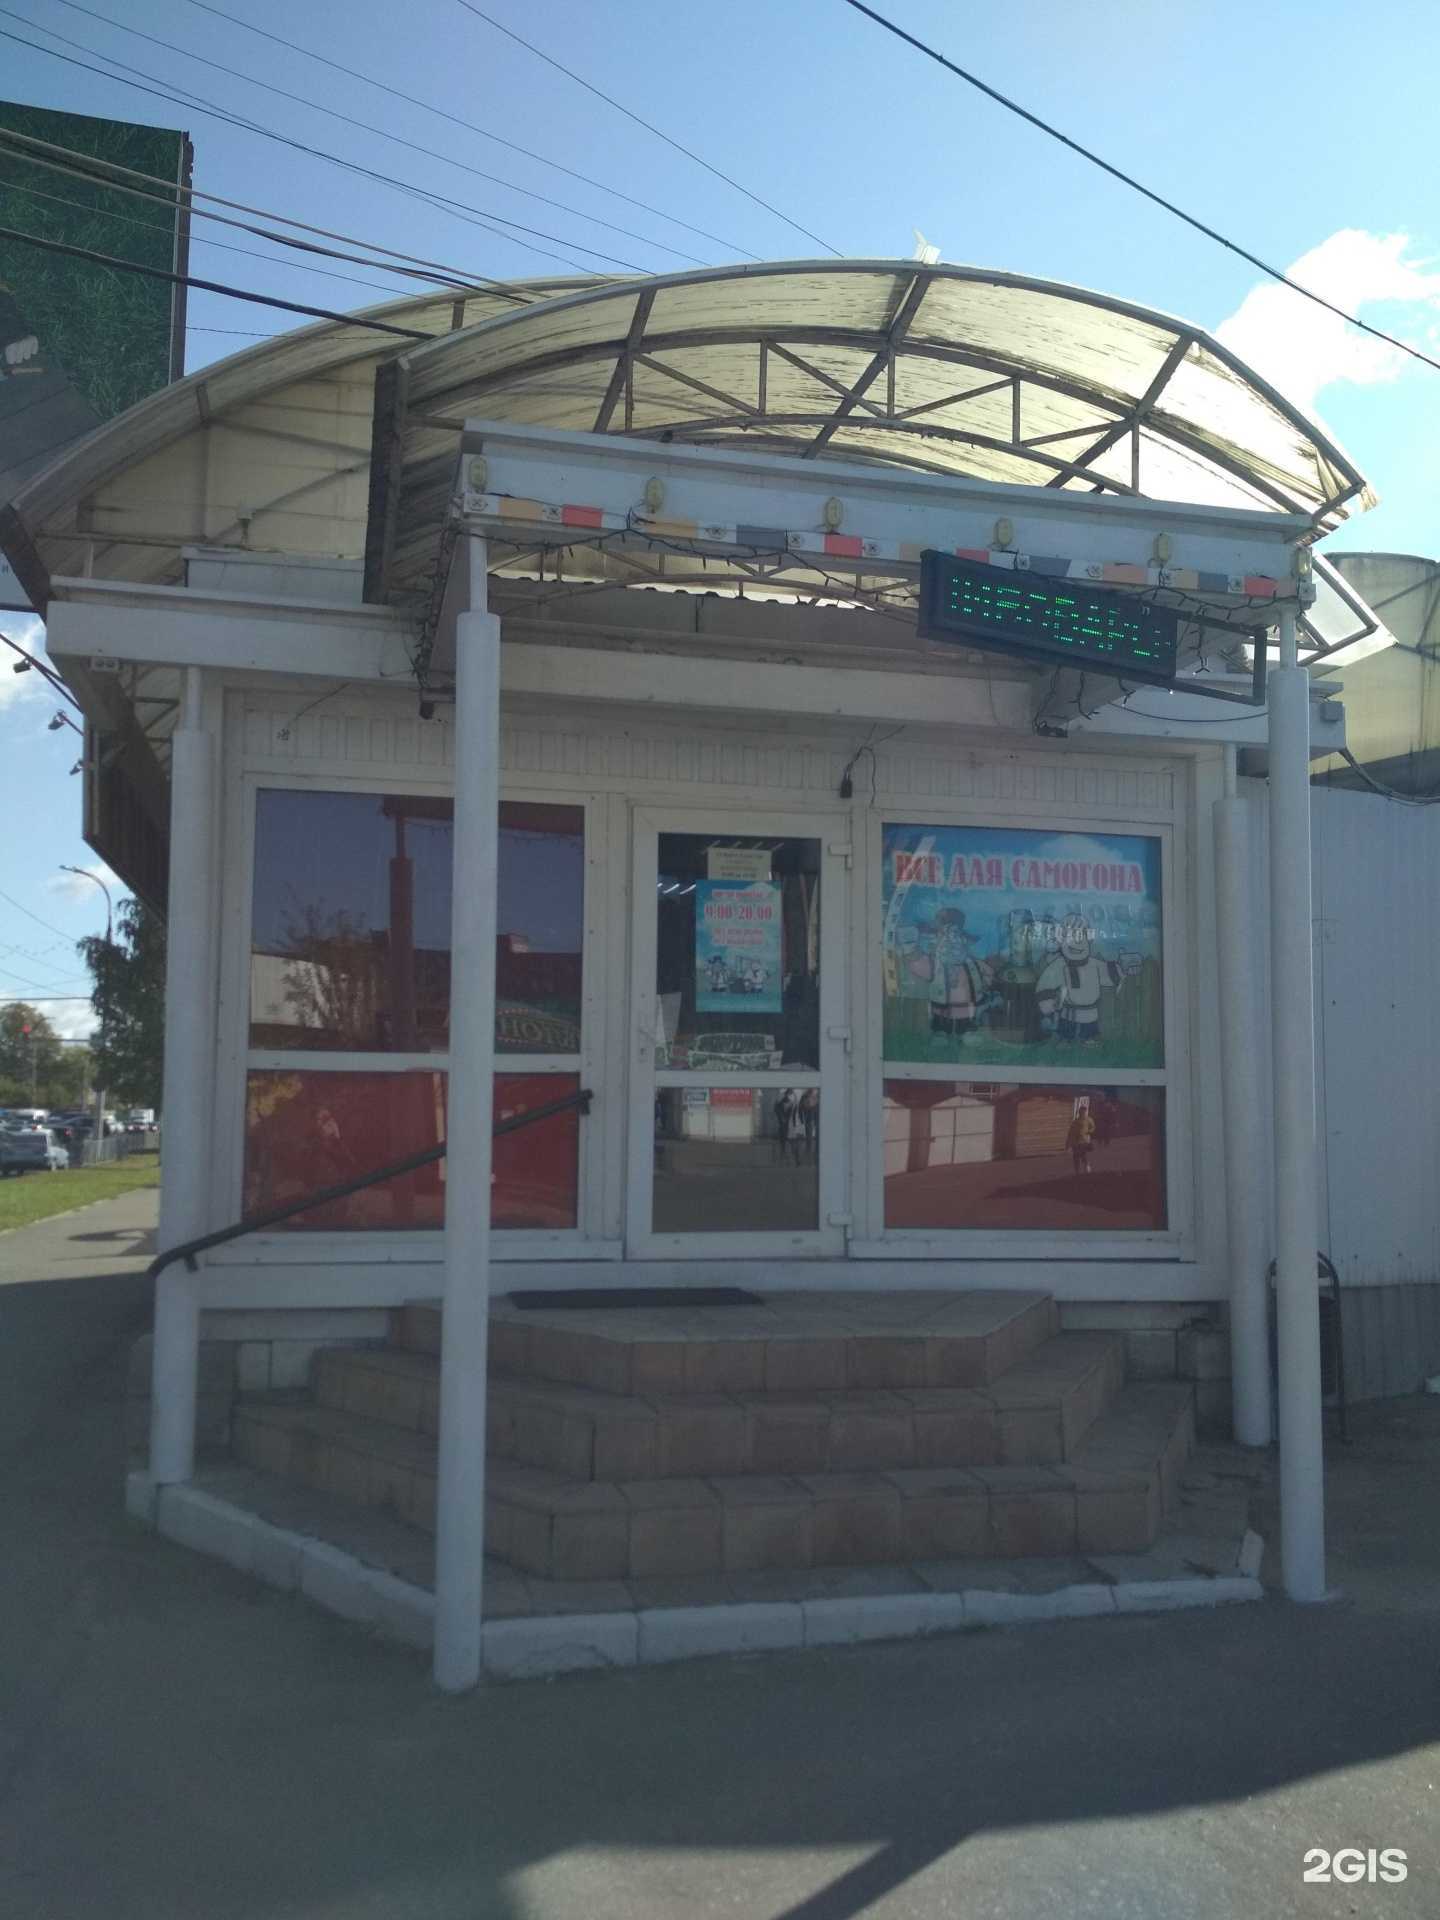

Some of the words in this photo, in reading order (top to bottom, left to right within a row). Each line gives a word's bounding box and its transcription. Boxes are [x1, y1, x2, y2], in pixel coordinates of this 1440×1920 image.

[894, 854, 941, 884] ВСЕ
[949, 856, 1003, 888] ДЛЯ
[1011, 858, 1144, 893] САМОГОНА
